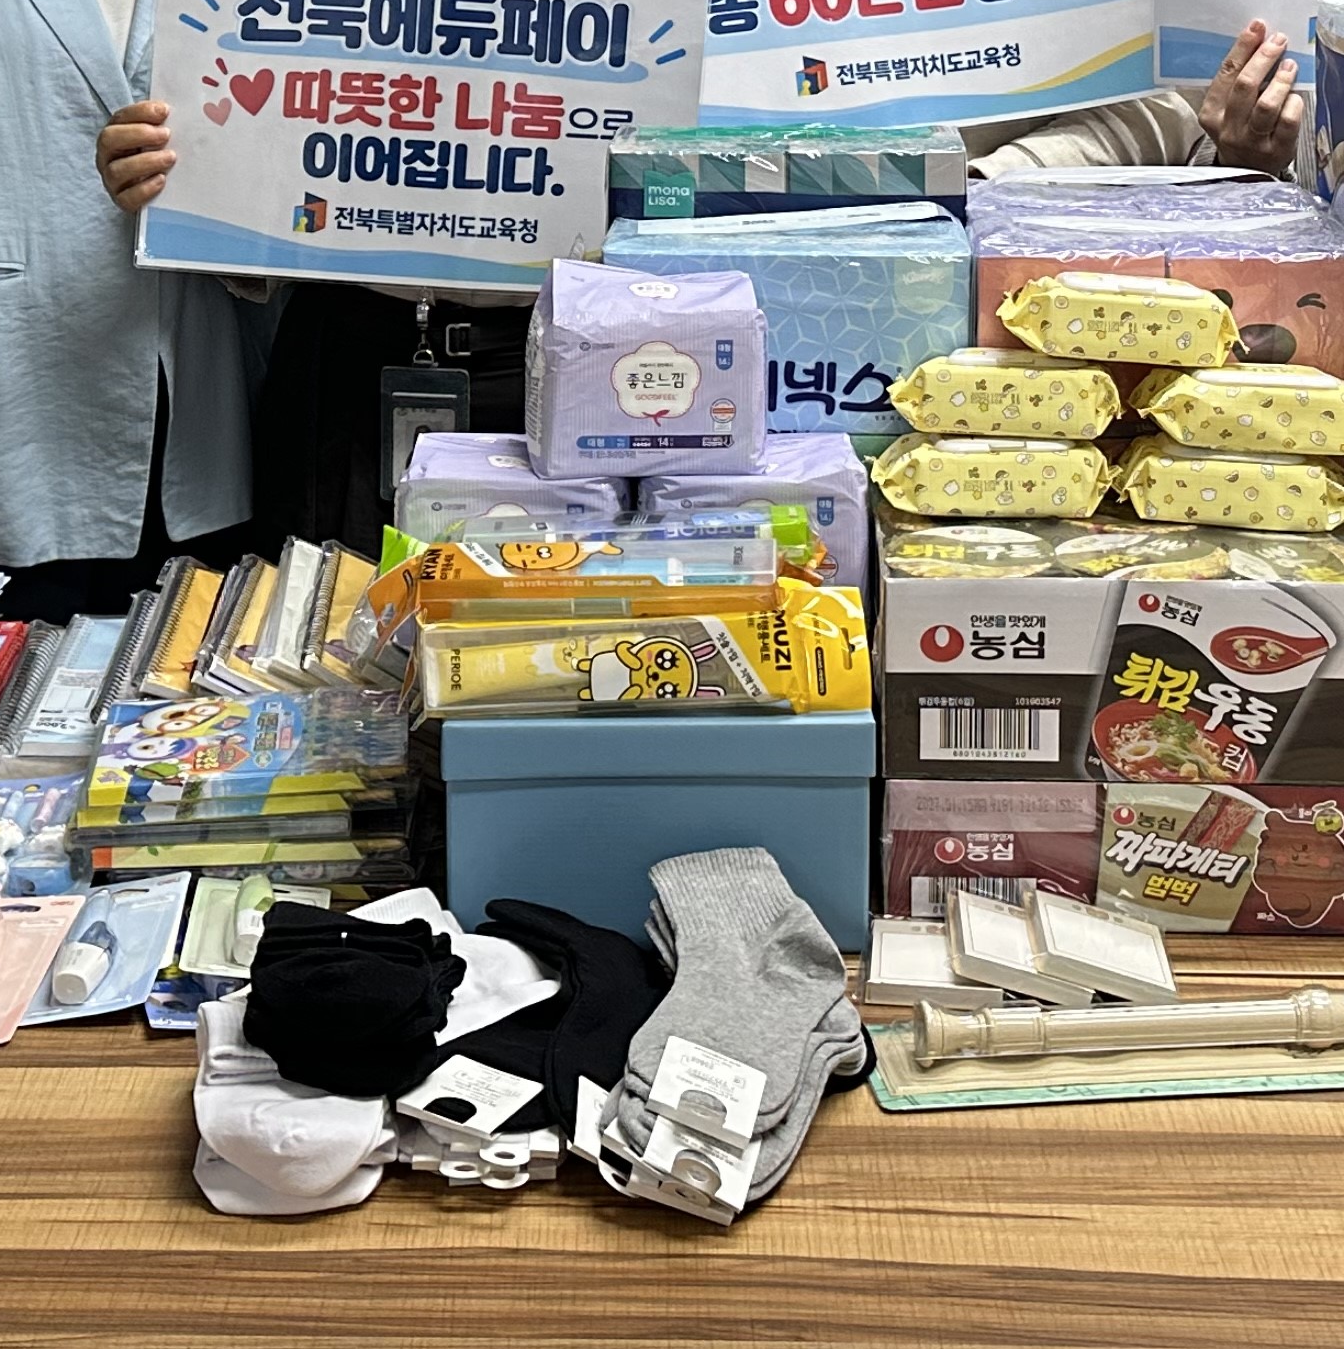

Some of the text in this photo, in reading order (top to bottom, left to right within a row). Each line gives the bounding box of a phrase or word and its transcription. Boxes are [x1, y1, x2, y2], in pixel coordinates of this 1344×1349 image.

[835, 42, 1023, 87] 전북특별자치도교육청
[282, 68, 635, 142] 따뜻한 나눔으로
[301, 131, 566, 198] 이어집니다.
[648, 185, 691, 197] mona
[333, 205, 540, 245] 전북특별자치도교육청
[626, 373, 686, 390] 좋은느낌
[768, 360, 899, 416] 넥스
[420, 548, 443, 580] RYAN
[1160, 602, 1201, 628] 농심
[772, 609, 793, 671] MUZI
[969, 630, 1046, 661] 농심
[1222, 743, 1249, 773] 컵
[1136, 812, 1177, 832] 농심
[966, 842, 1014, 861] 농심
[1105, 829, 1251, 887] 짜파게티
[1143, 874, 1202, 905] 범벅
